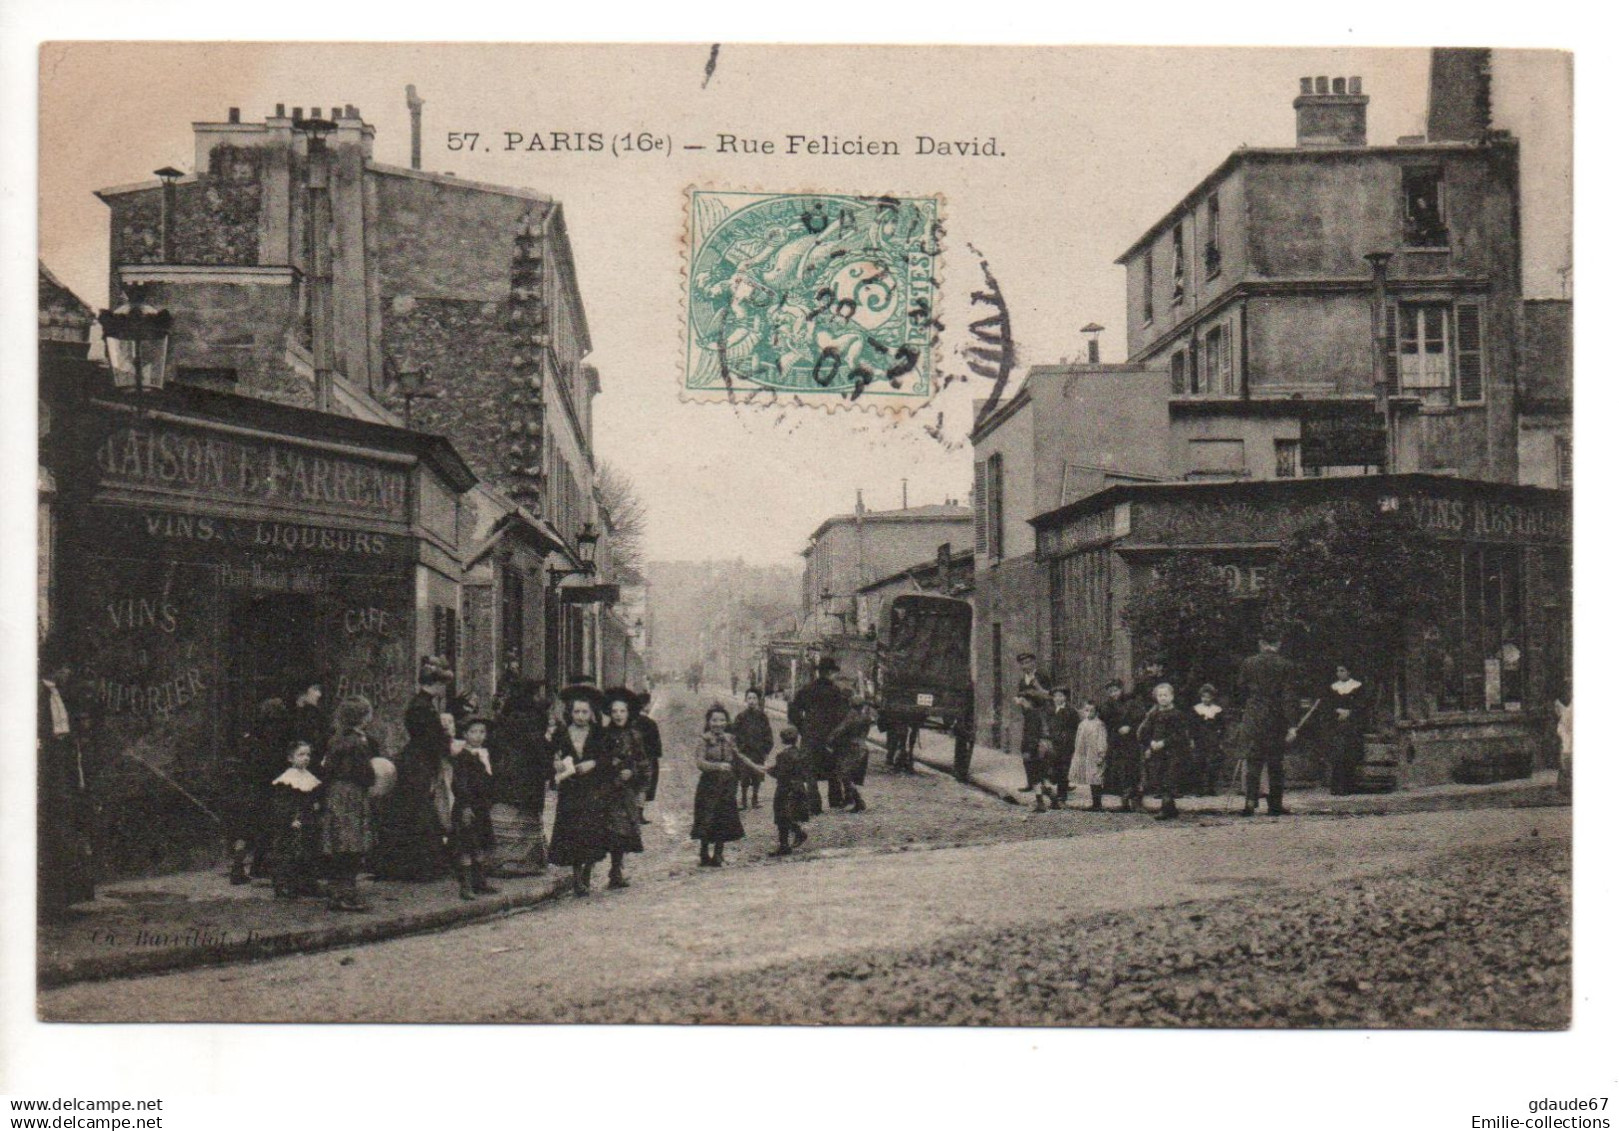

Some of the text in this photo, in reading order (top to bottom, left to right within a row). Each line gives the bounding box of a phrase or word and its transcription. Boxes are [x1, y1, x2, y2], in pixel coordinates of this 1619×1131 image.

[447, 131, 490, 153] 57.
[504, 131, 604, 152] PARIS
[716, 133, 775, 155] Rue
[785, 134, 900, 156] Felicien
[915, 136, 1006, 157] David.
[253, 523, 386, 555] LIQUEURS
[106, 597, 179, 633] VINS
